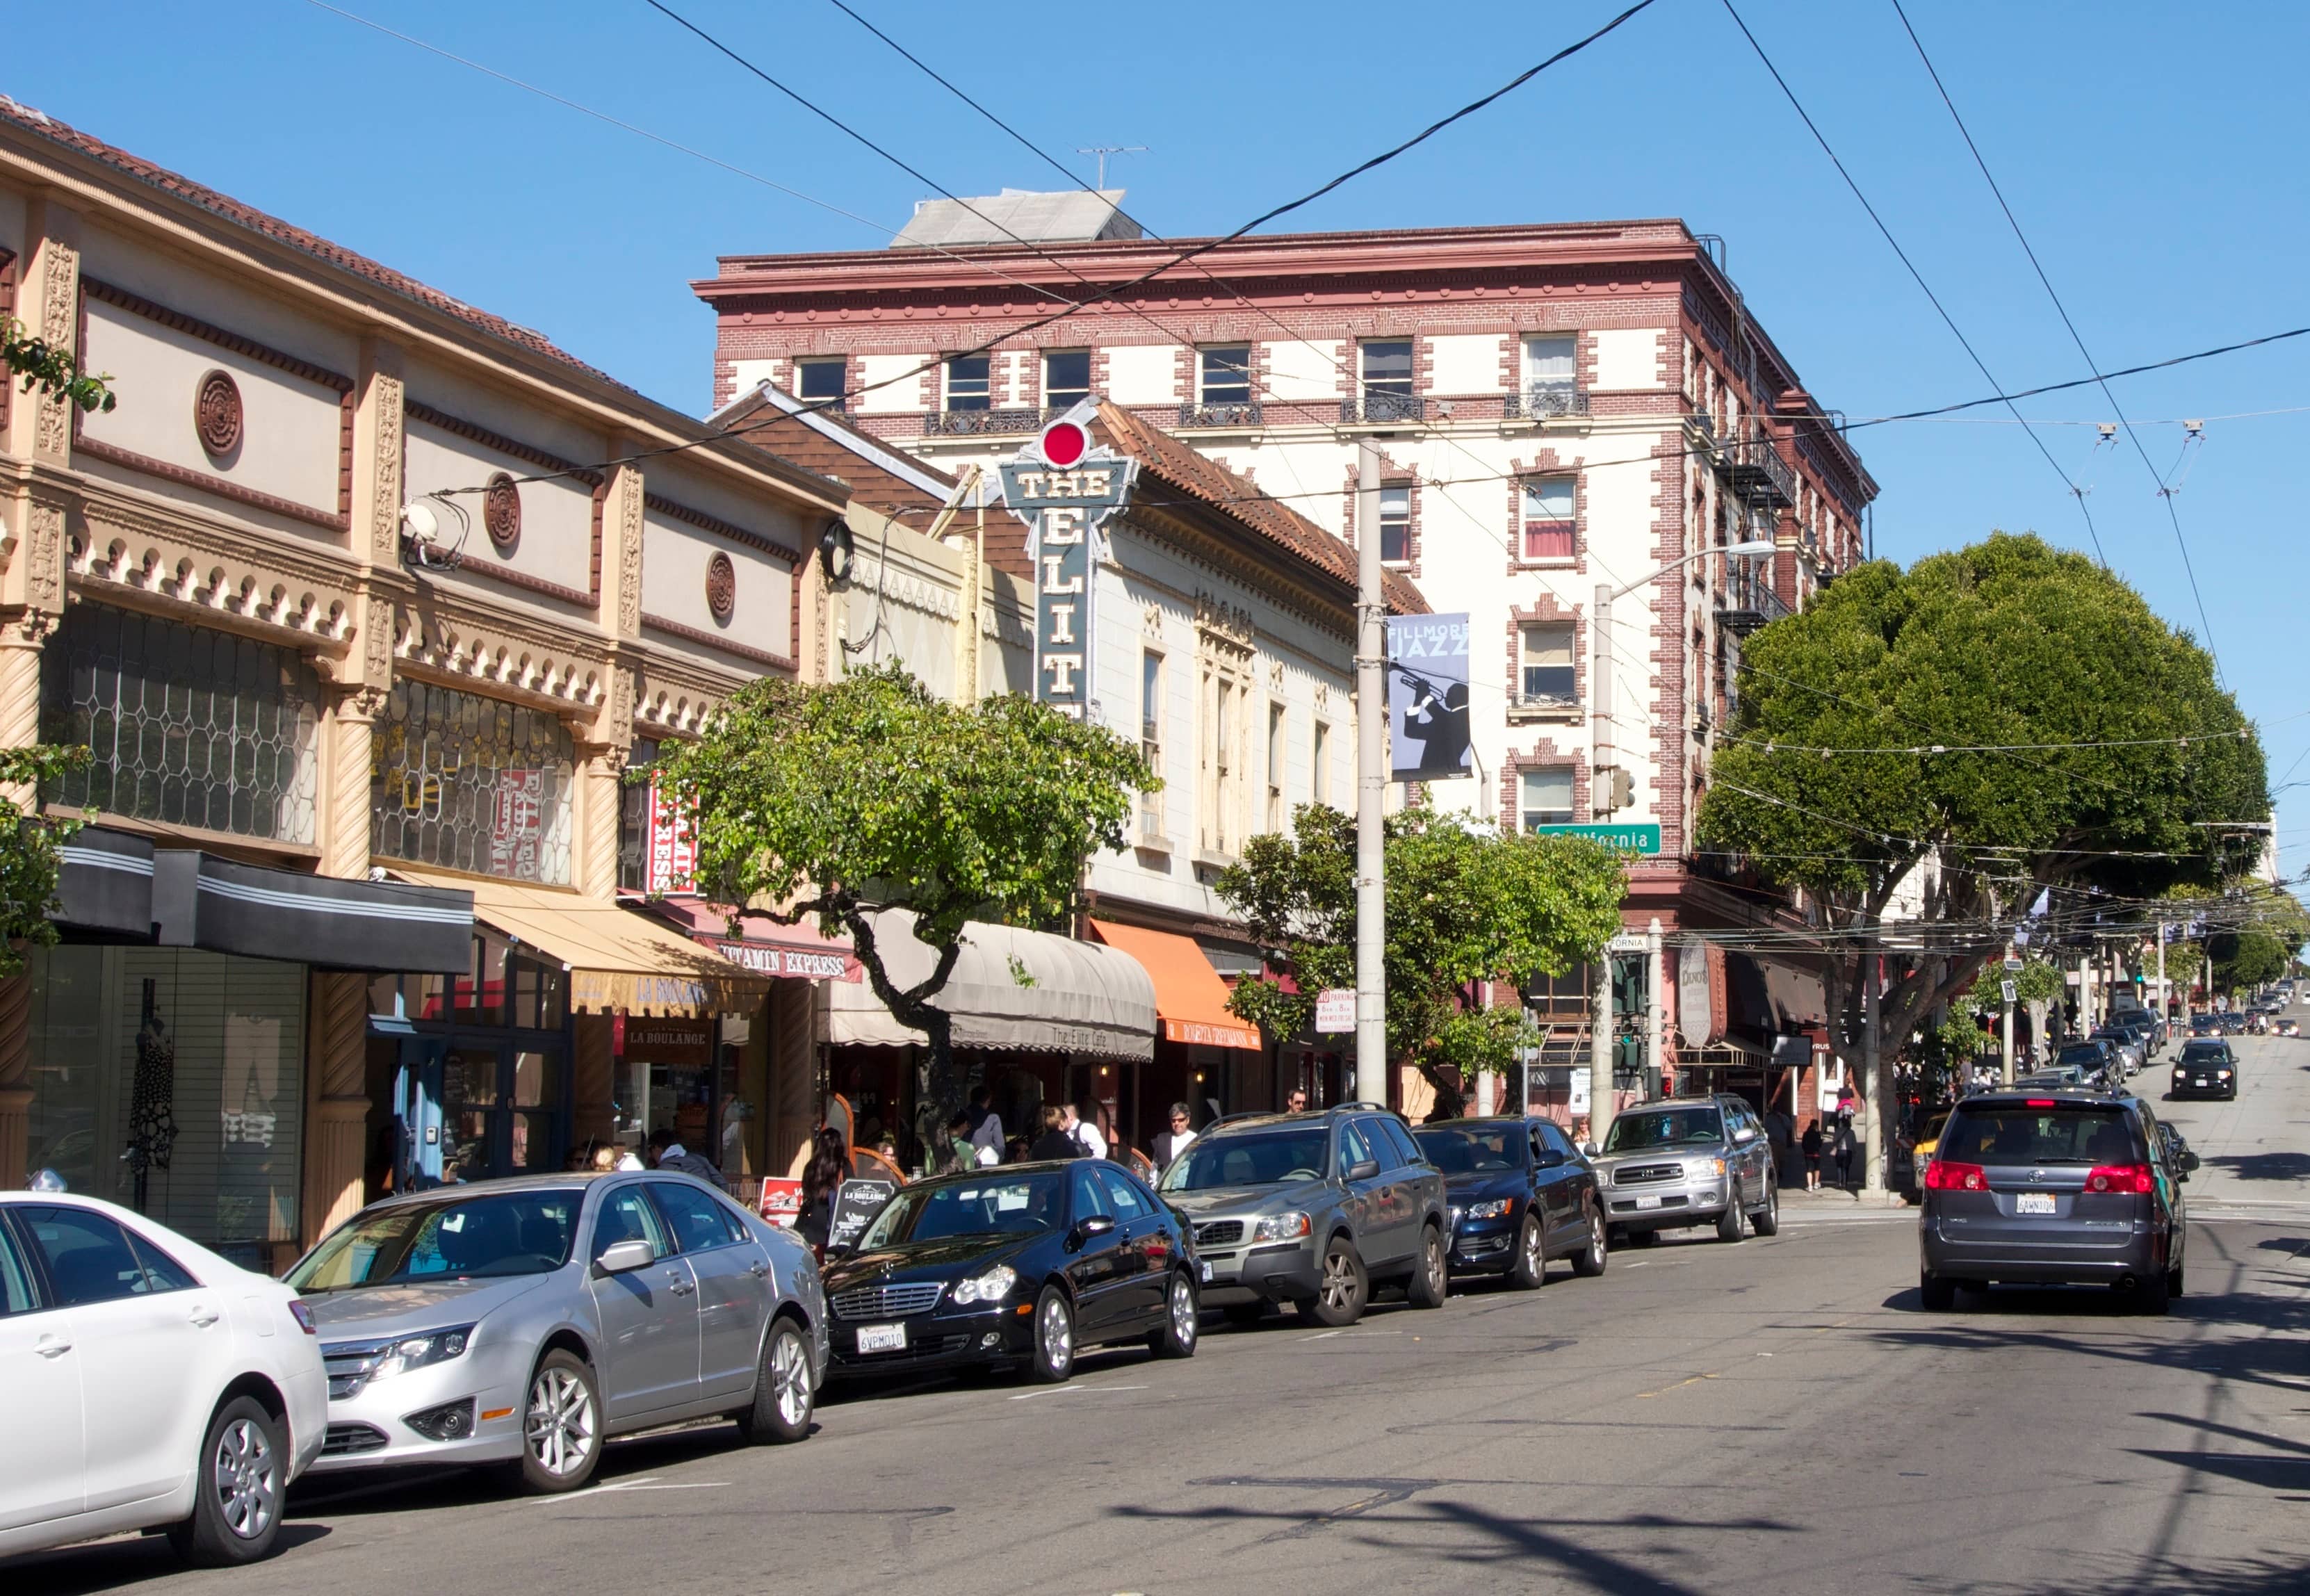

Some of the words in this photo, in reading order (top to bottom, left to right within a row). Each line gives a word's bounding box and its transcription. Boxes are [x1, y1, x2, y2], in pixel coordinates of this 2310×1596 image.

[1018, 469, 1111, 498] THE
[1043, 507, 1083, 719] ELIT
[1388, 624, 1469, 640] FILLMORE
[1388, 635, 1469, 658] JAZZ
[785, 951, 846, 977] EXPRESS
[1318, 991, 1329, 1002] NO
[1331, 993, 1354, 1002] PARKING
[630, 1032, 644, 1044] LA
[646, 1032, 706, 1045] BOULANGE
[1052, 1027, 1068, 1044] The
[1071, 1028, 1089, 1045] Elite
[854, 1192, 886, 1200] BOULANGE
